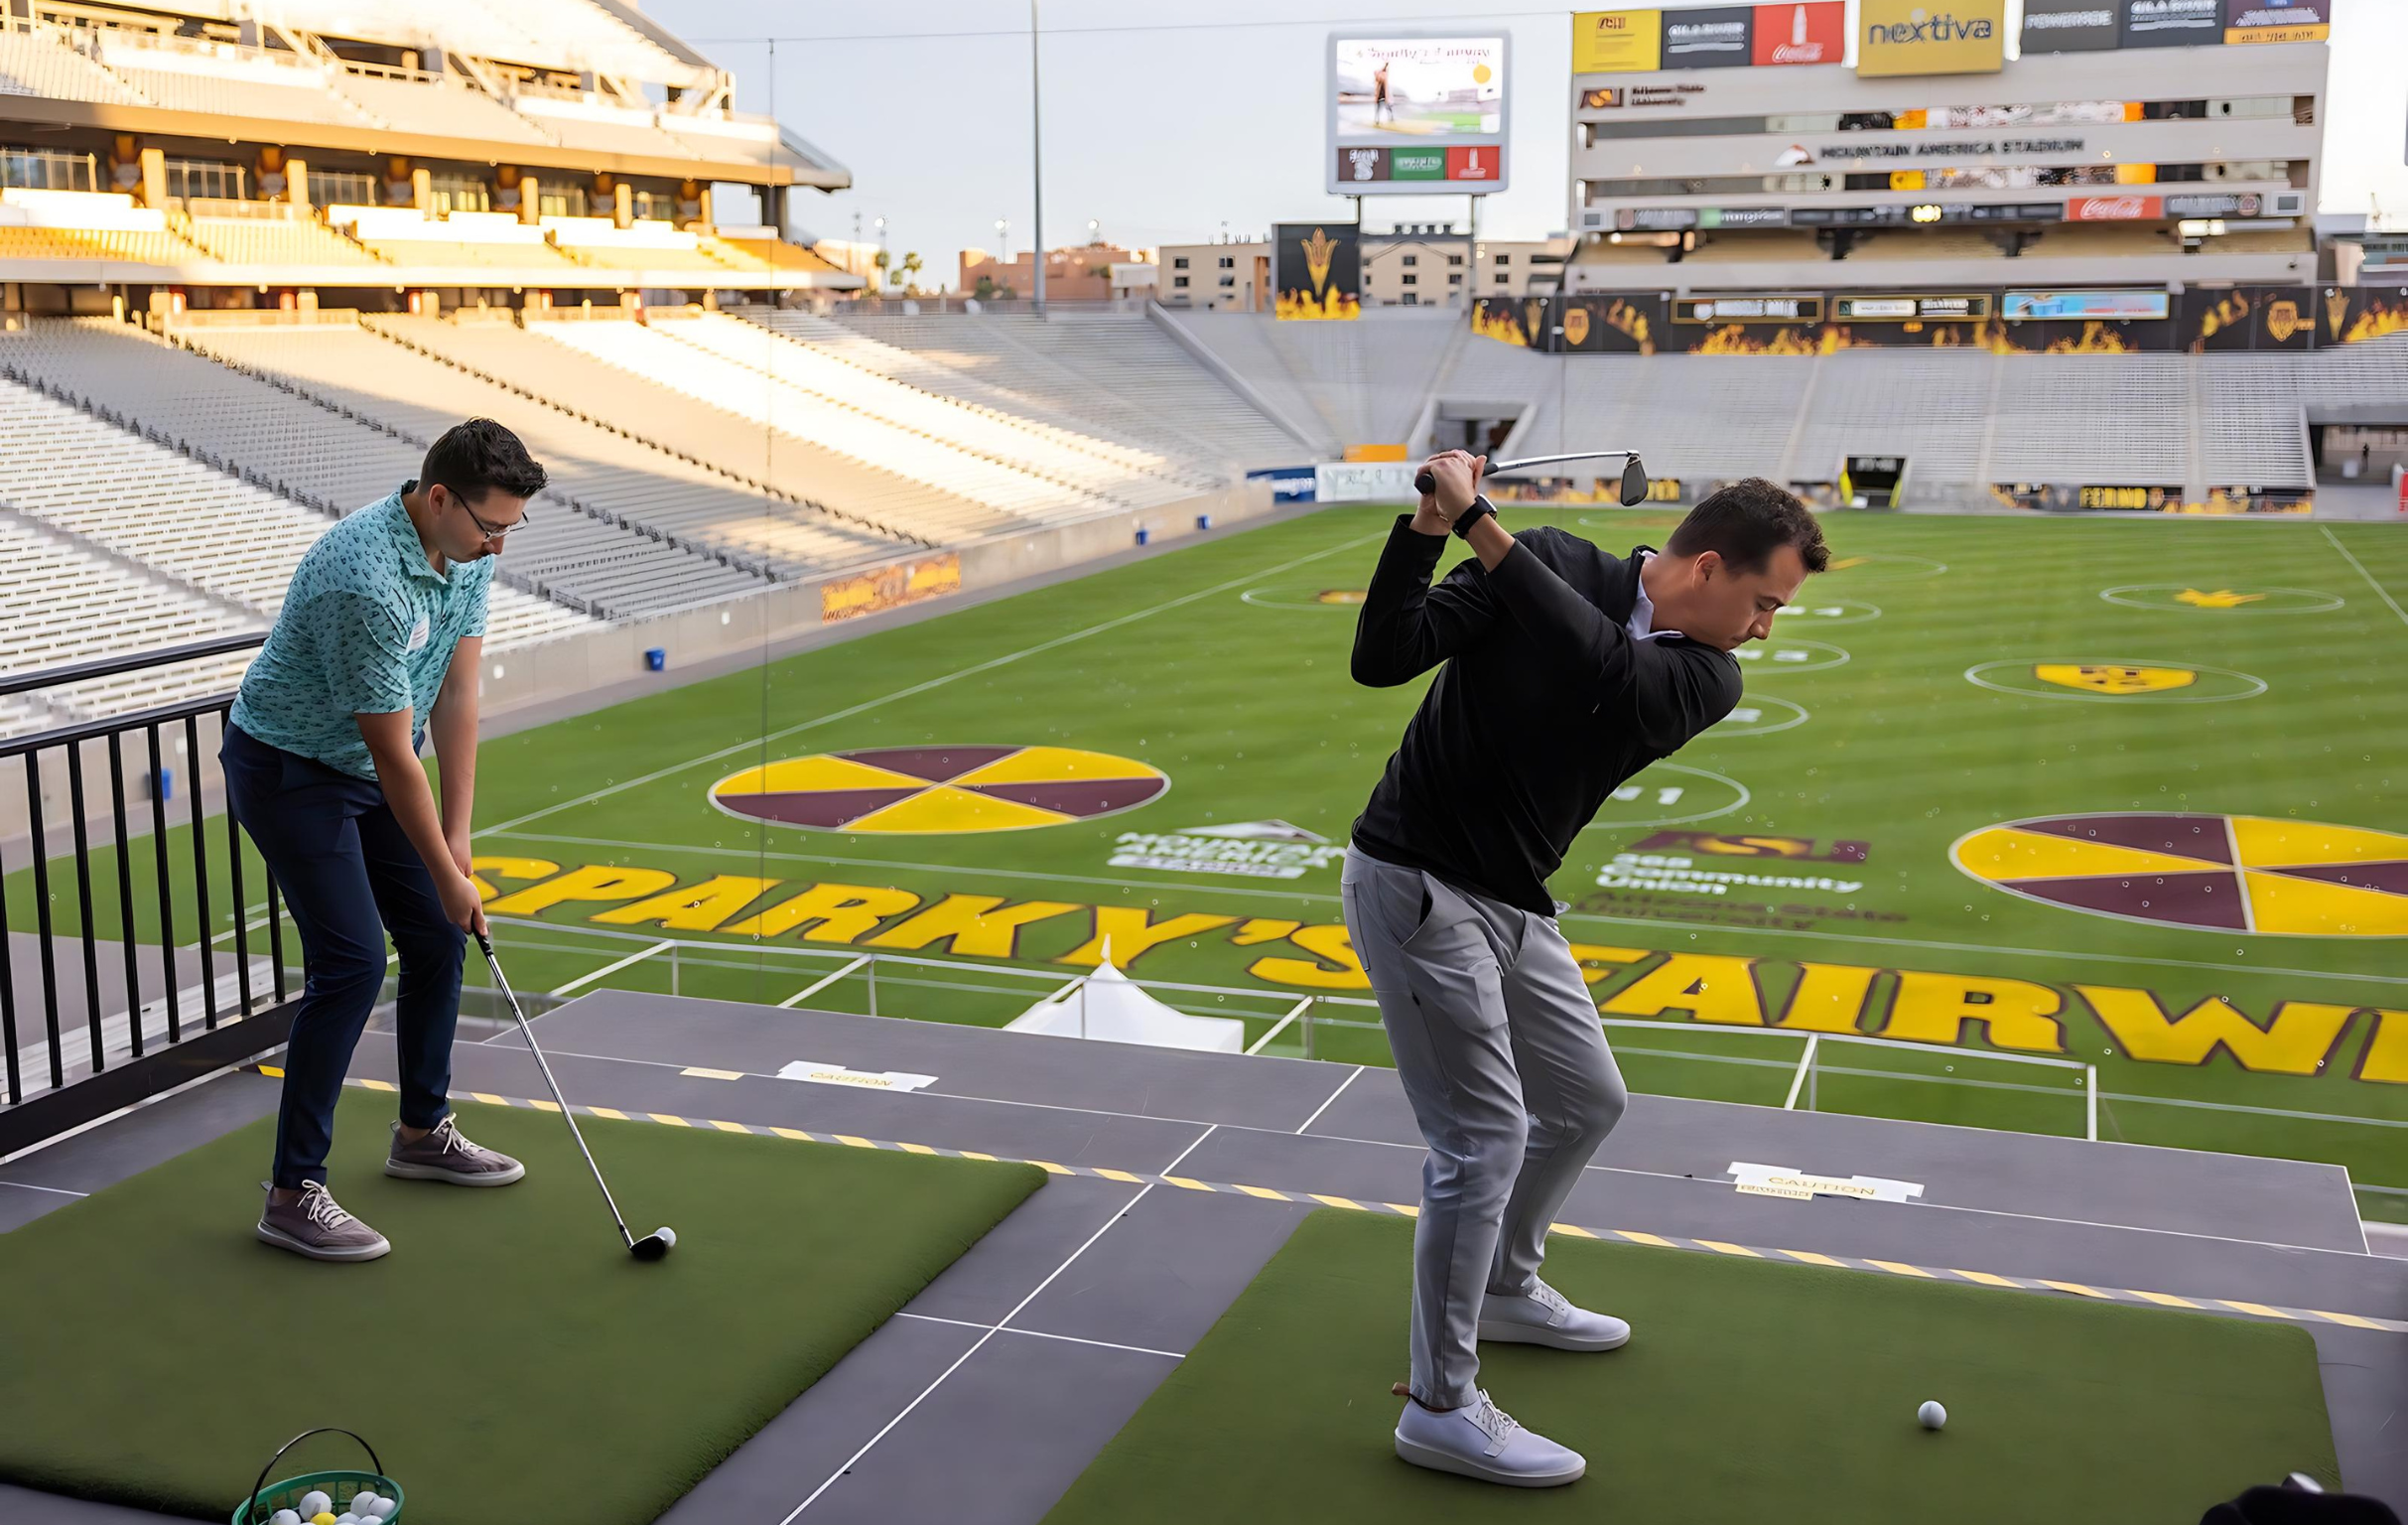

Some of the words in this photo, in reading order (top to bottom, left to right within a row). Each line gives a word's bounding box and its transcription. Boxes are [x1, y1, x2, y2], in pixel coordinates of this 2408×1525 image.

[1869, 13, 1992, 44] nextiva
[470, 856, 1373, 990] SPARKY'S
[1567, 942, 2408, 1084] AIRW
[1768, 1177, 1875, 1195] CAUTION
